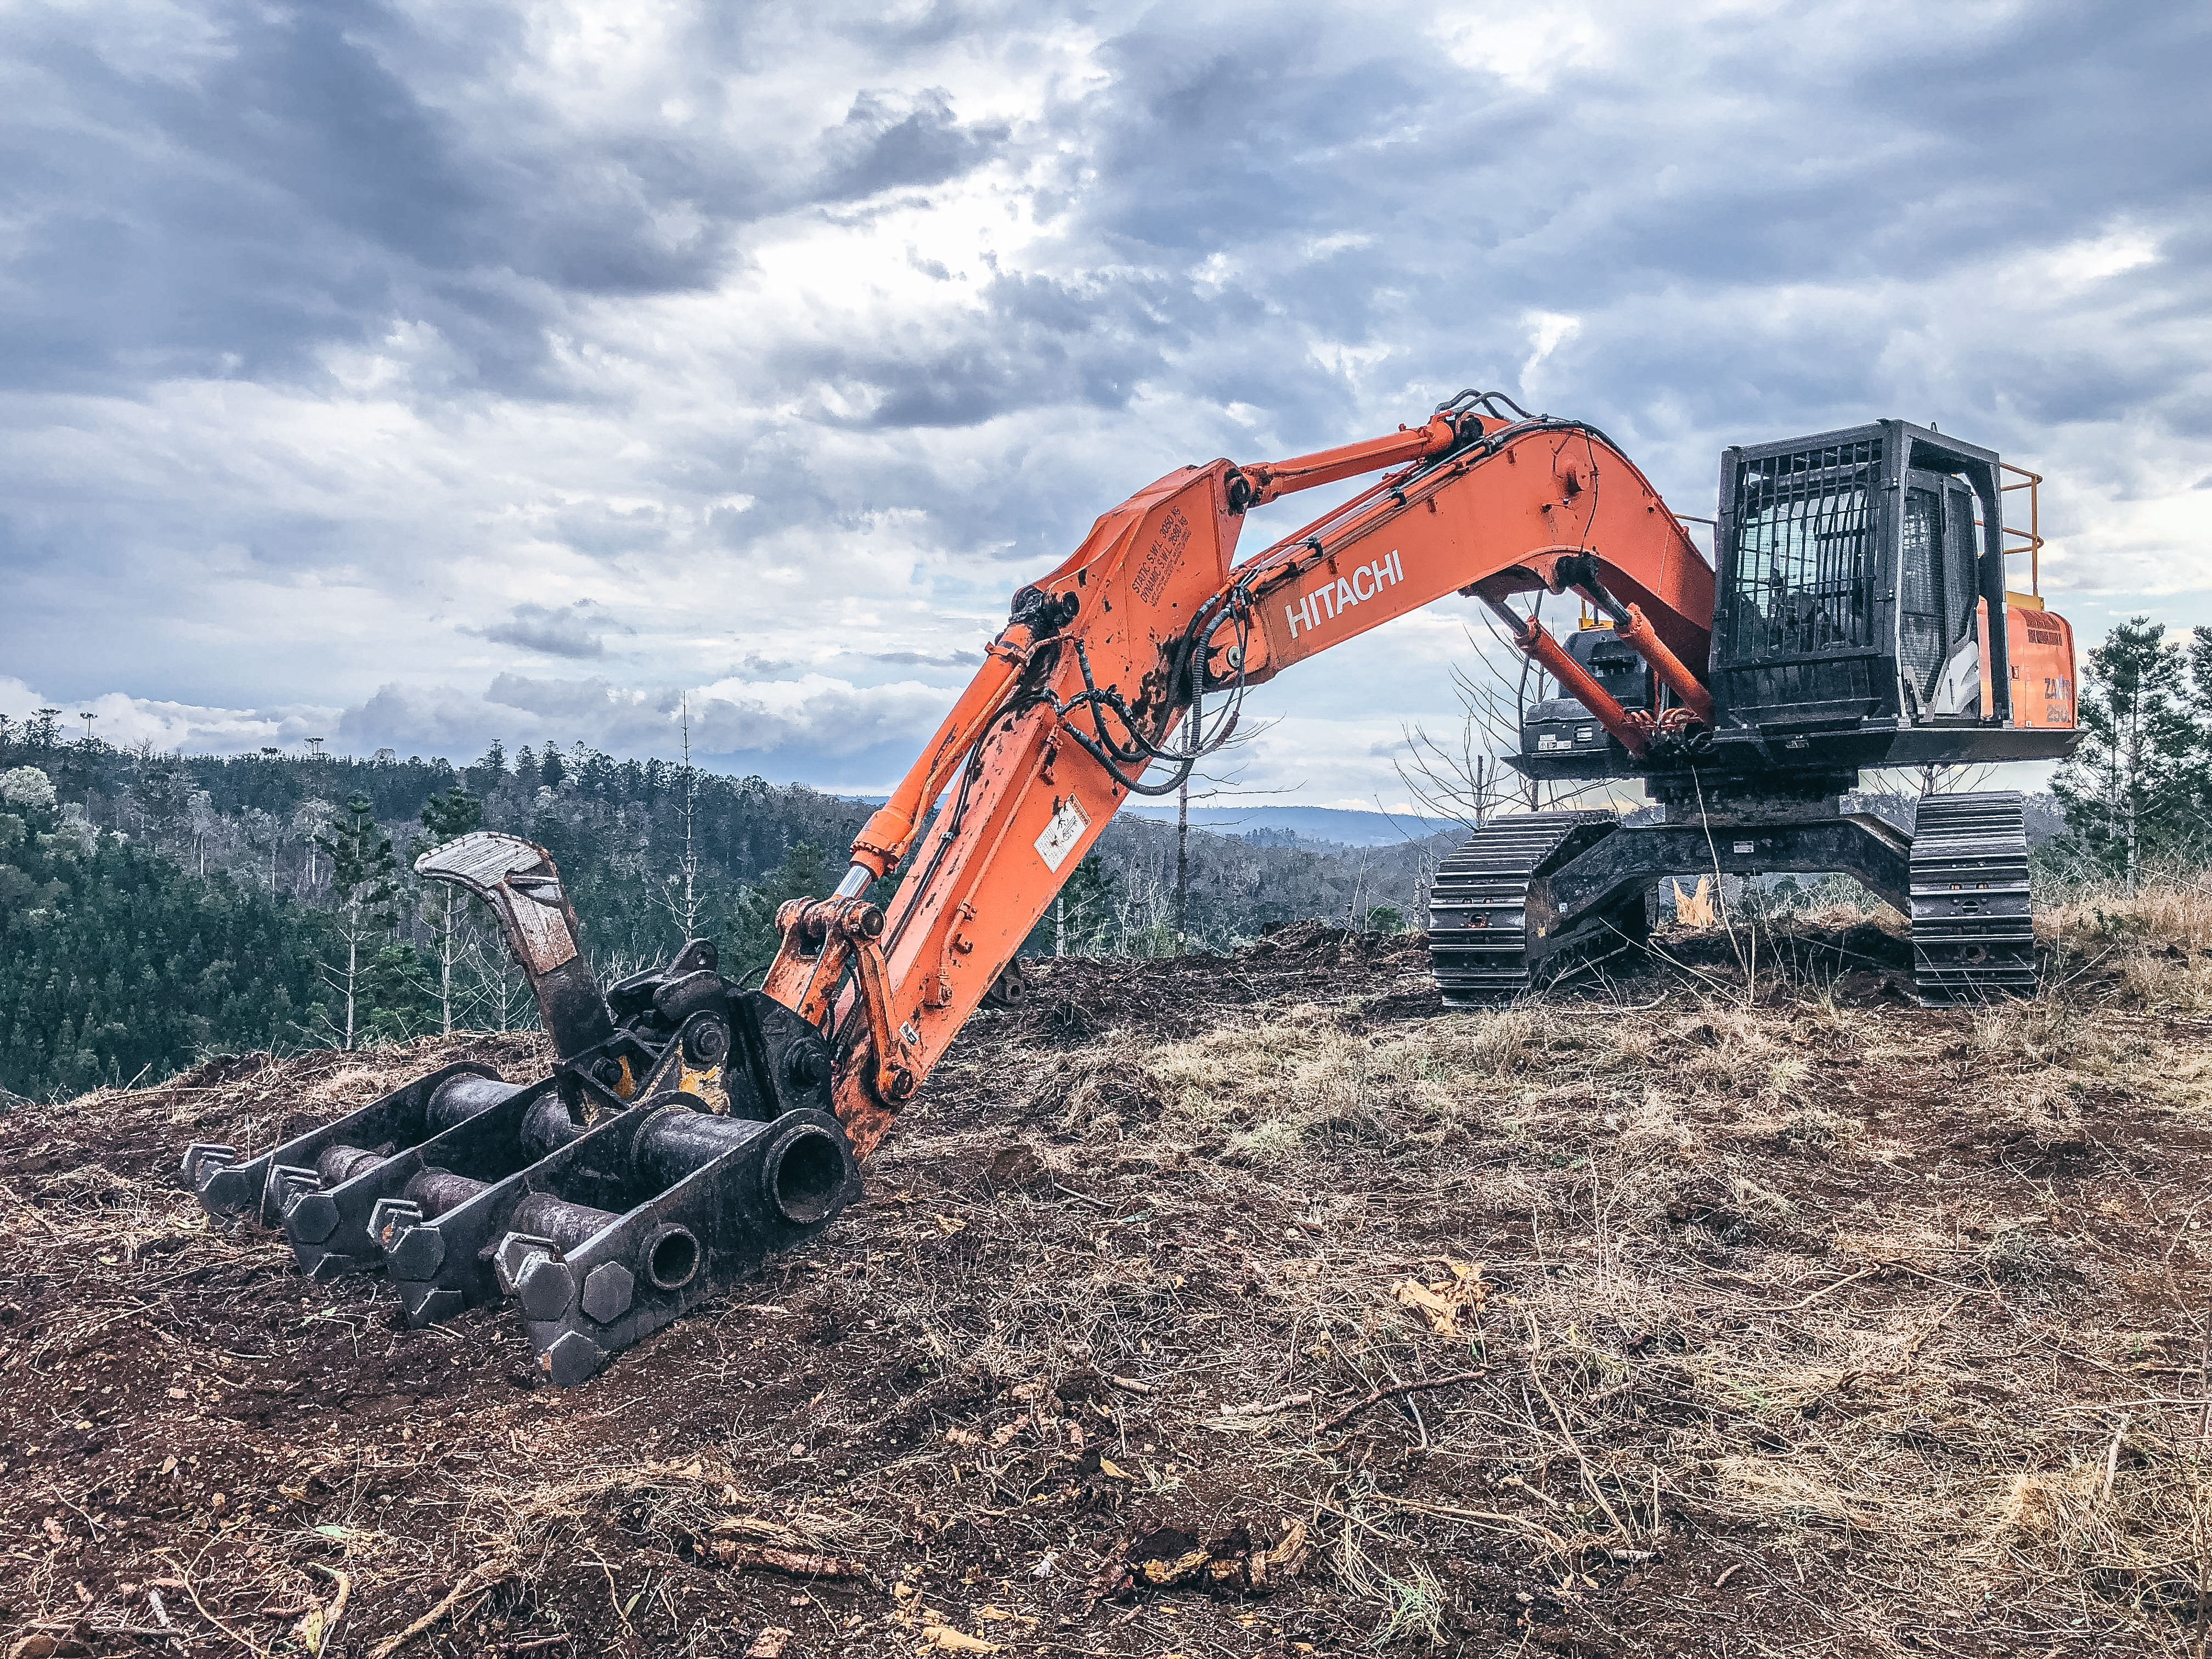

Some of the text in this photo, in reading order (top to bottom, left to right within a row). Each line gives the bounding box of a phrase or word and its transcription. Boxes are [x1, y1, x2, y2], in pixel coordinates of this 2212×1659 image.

[1132, 562, 1150, 594] STATIC
[1141, 566, 1161, 603] DYNAMIC
[1285, 549, 1404, 639] HITACHI
